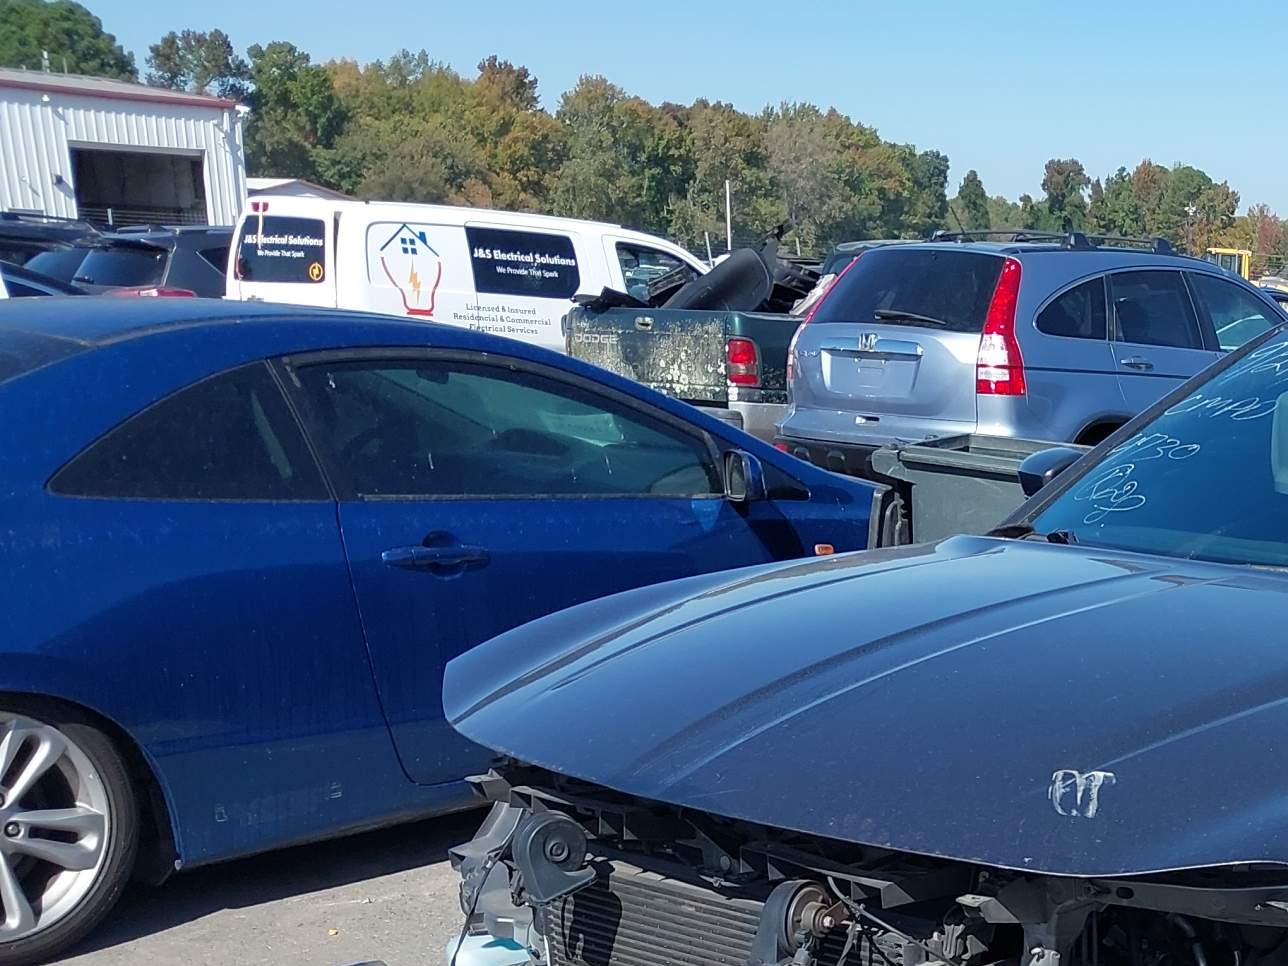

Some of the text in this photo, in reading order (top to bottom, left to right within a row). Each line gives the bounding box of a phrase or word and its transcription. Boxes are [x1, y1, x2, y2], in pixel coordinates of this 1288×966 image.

[244, 234, 257, 244] J&S
[288, 235, 324, 246] Solutions
[473, 247, 576, 266] J&S Electrical Solutions
[495, 265, 559, 279] We Provide That Spark
[465, 303, 500, 312] Licensed
[507, 305, 536, 315] Insured
[505, 315, 551, 326] Commercial
[507, 325, 538, 334] Services
[575, 333, 618, 344] DODGE
